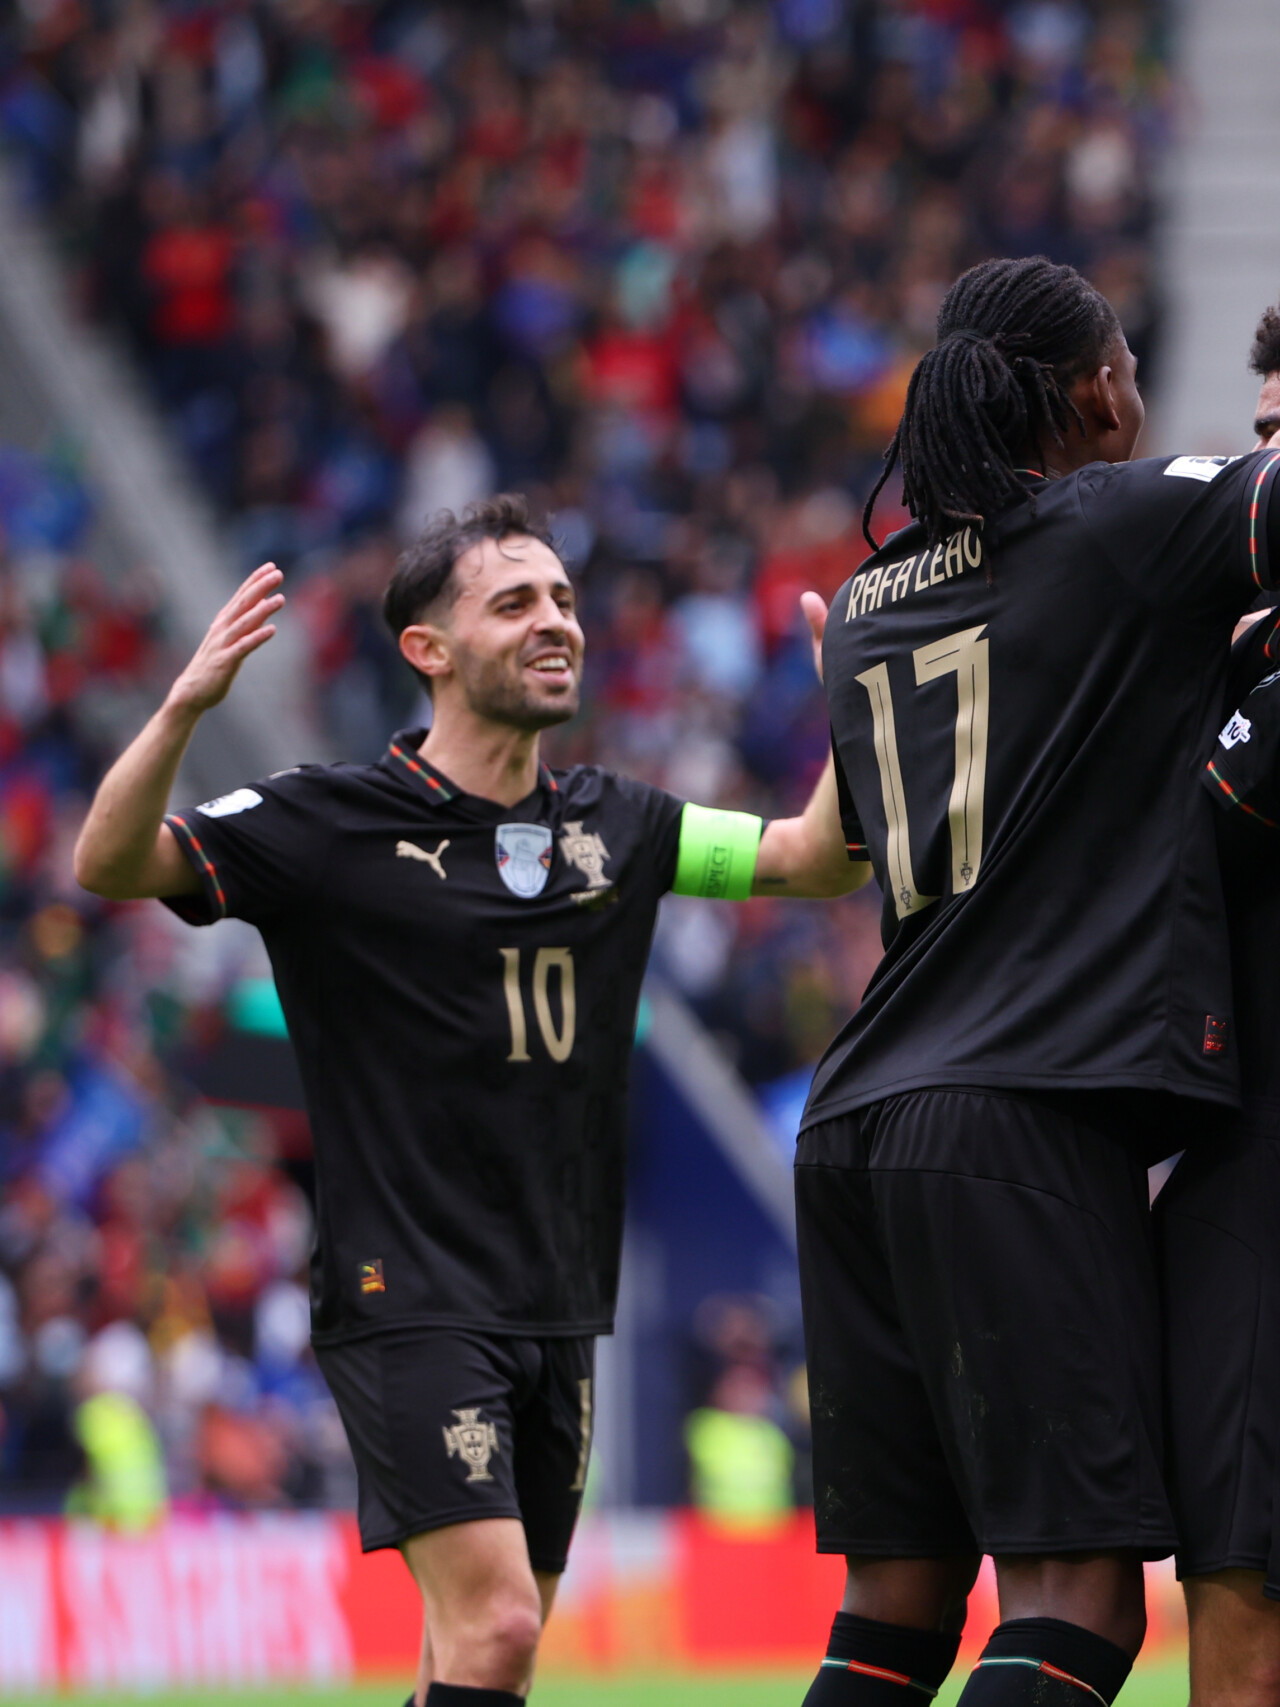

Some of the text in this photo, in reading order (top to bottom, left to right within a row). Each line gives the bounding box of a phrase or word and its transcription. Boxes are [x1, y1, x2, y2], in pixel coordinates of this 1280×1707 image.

[845, 555, 917, 623] RAFA
[854, 624, 990, 920] 17
[499, 946, 576, 1063] 10
